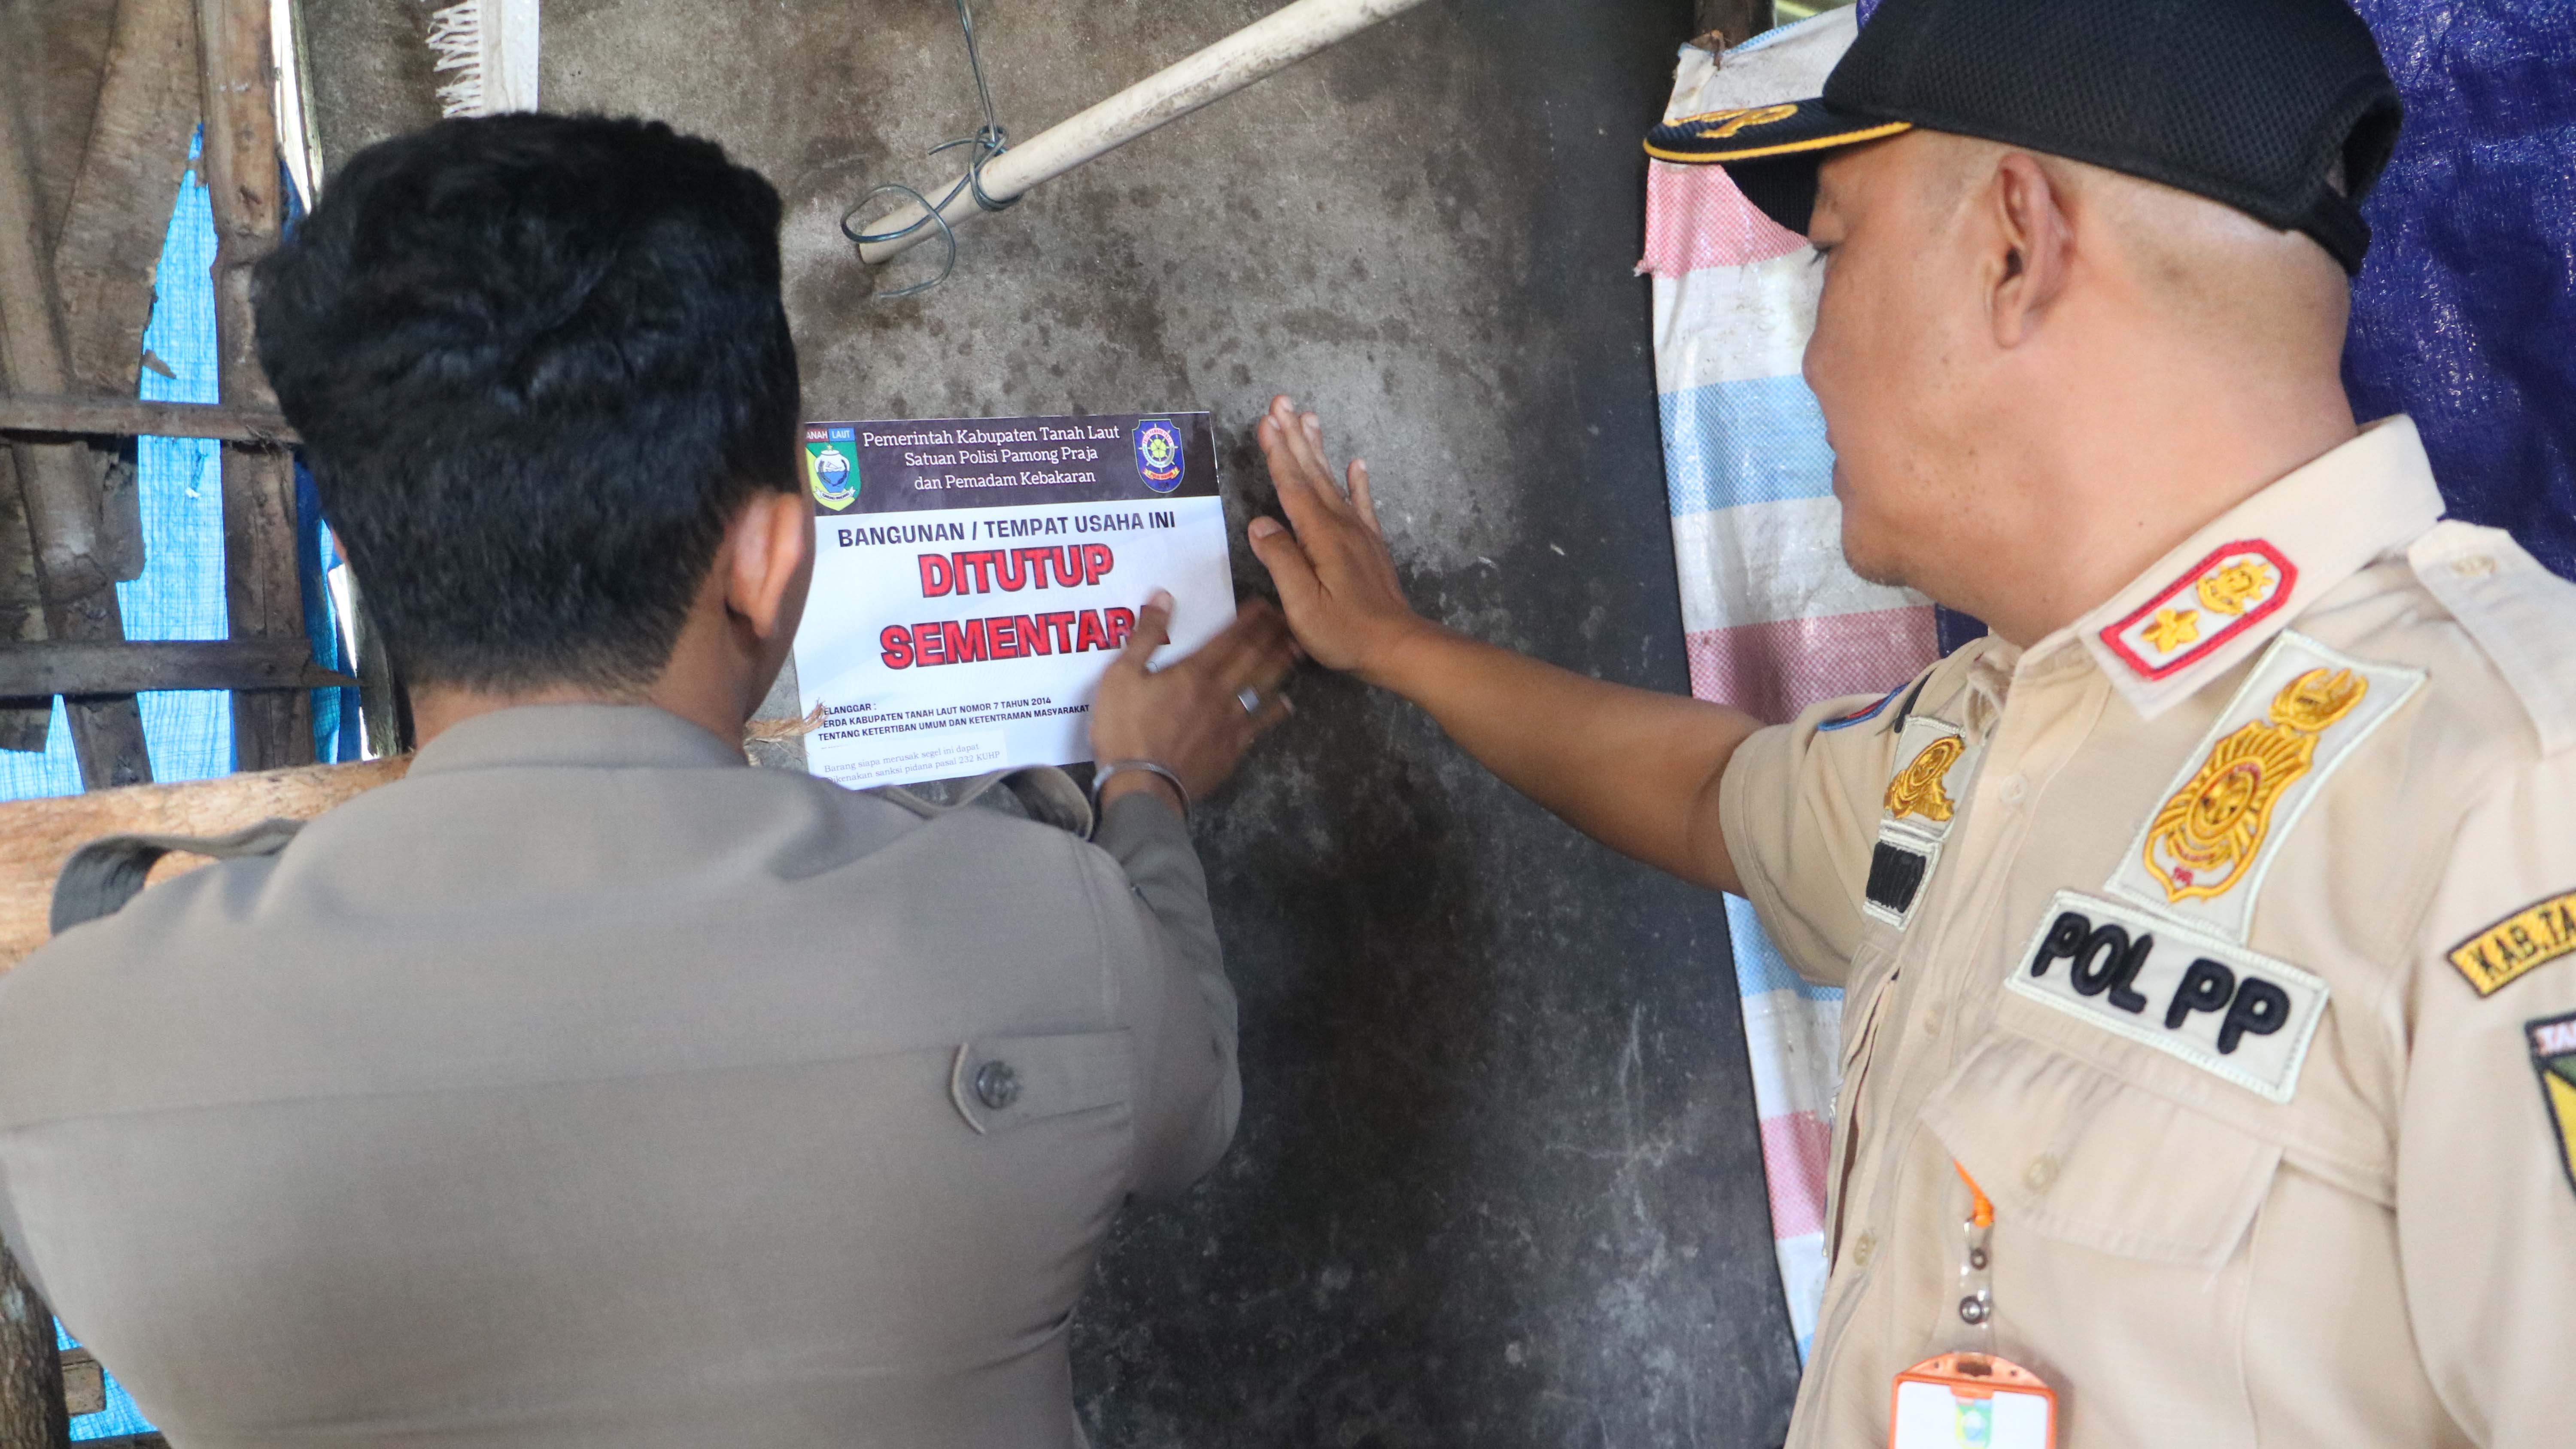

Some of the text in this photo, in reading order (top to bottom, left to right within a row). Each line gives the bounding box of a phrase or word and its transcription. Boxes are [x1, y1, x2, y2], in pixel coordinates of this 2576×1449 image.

[805, 430, 850, 439] ANAH LAUT
[863, 425, 1120, 447] Pemerintah Kabupaten Tanah Laut
[905, 446, 1098, 466] Satuan Polisi Pamong Praja
[914, 471, 1096, 490] dan Pemadam Kebakaran
[838, 522, 965, 547] BANGUNAN
[984, 516, 1068, 538] TEMPAT
[1075, 513, 1145, 533] USAHA
[1149, 511, 1176, 529] INI
[917, 543, 1114, 598] DITUTUP
[880, 605, 1171, 670] SEMENTAR
[818, 705, 1089, 741] TENTANG KETERTIBAN UMUM DAN KETENTRAMAN MASYARAKAT
[823, 697, 1051, 728] ERDA KABUPATEN TANAH LAUT NOMOR 7 TAHUN 2014
[824, 703, 872, 715] ELANGGAR
[824, 743, 979, 773] Barang siapa merusak segel ini dapat
[875, 766, 902, 776] sanksi
[905, 762, 933, 773] pidana
[936, 757, 956, 769] pasal
[959, 755, 974, 764] 232
[976, 751, 1000, 761] KUHP
[2031, 911, 2290, 1055] POL PP
